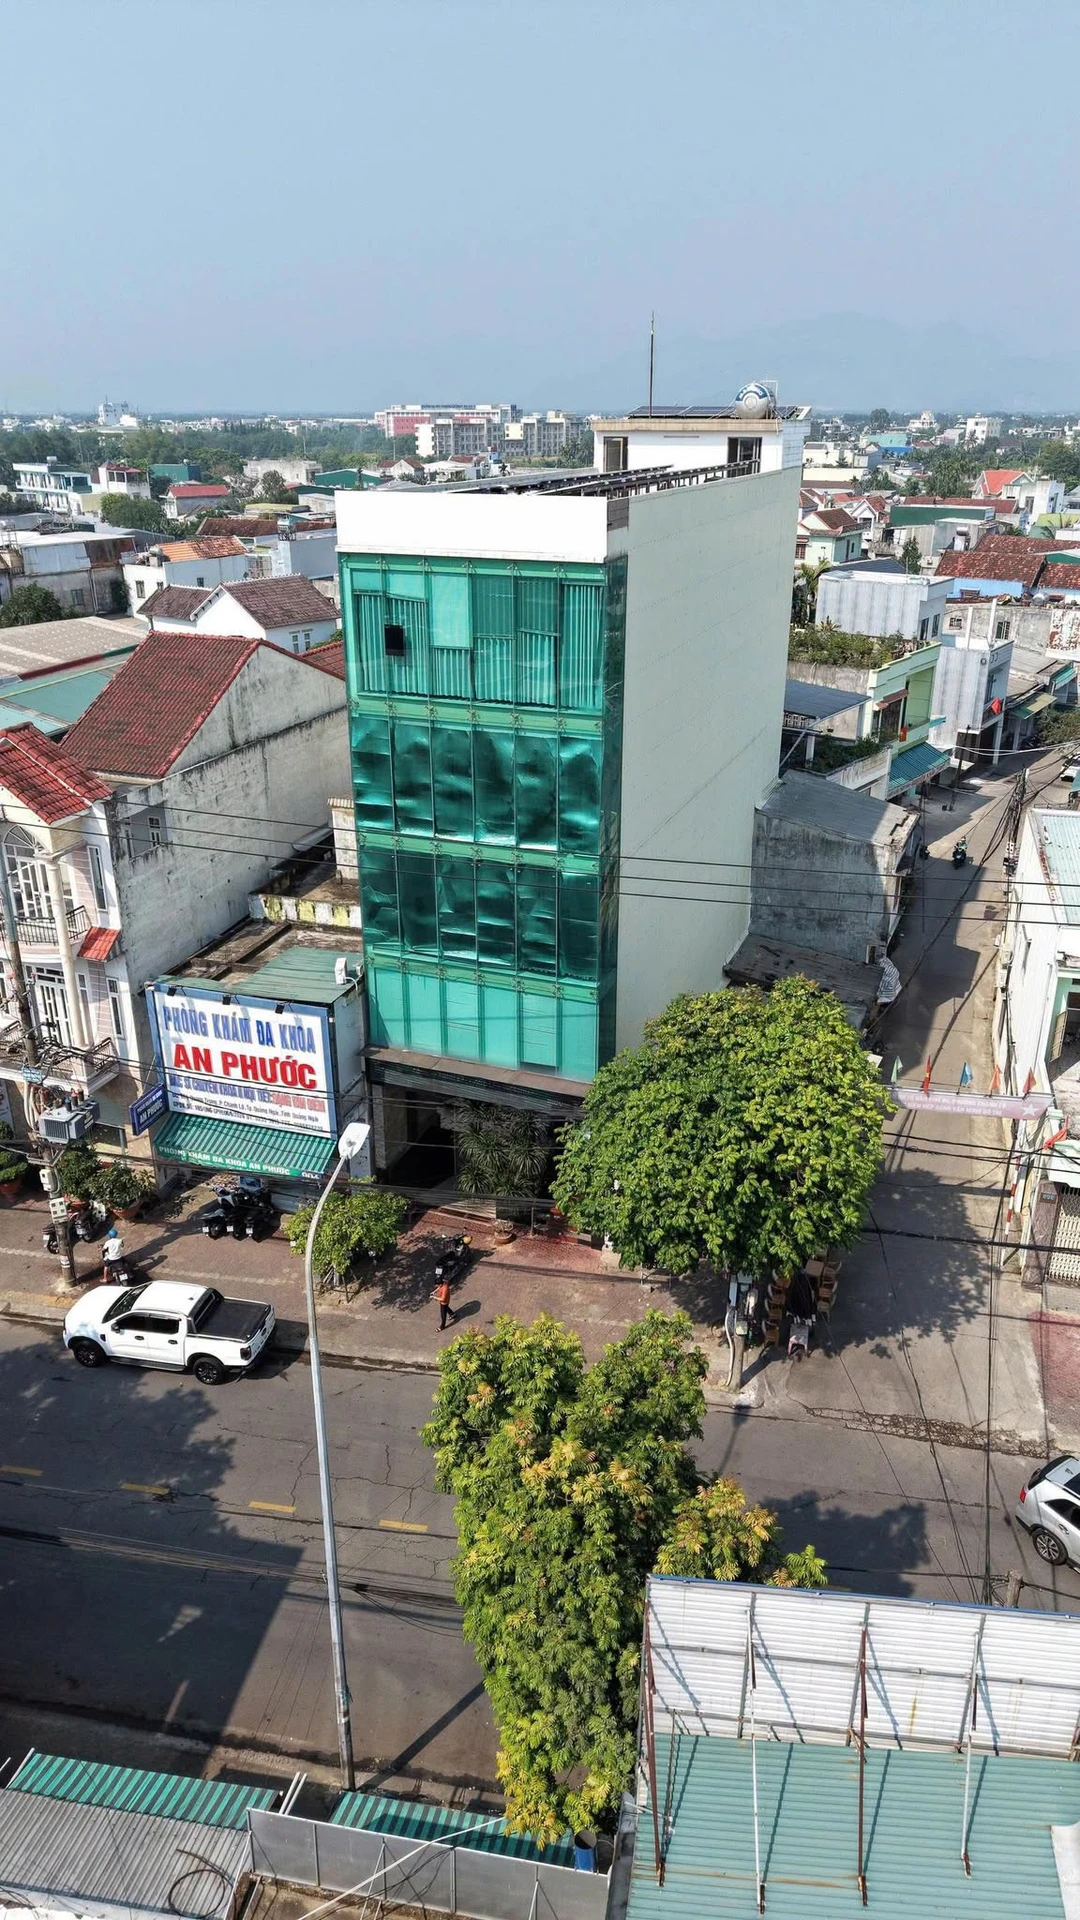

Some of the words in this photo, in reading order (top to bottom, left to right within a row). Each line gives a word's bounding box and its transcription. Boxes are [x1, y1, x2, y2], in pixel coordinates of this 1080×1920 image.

[164, 1003, 208, 1036] PHÒNG
[211, 1011, 252, 1043] KHÁM
[256, 1020, 275, 1046] ĐA
[278, 1023, 316, 1053] KHOA
[173, 1043, 213, 1073] AN
[221, 1051, 316, 1089] PHƯỚC
[139, 1111, 147, 1124] AN
